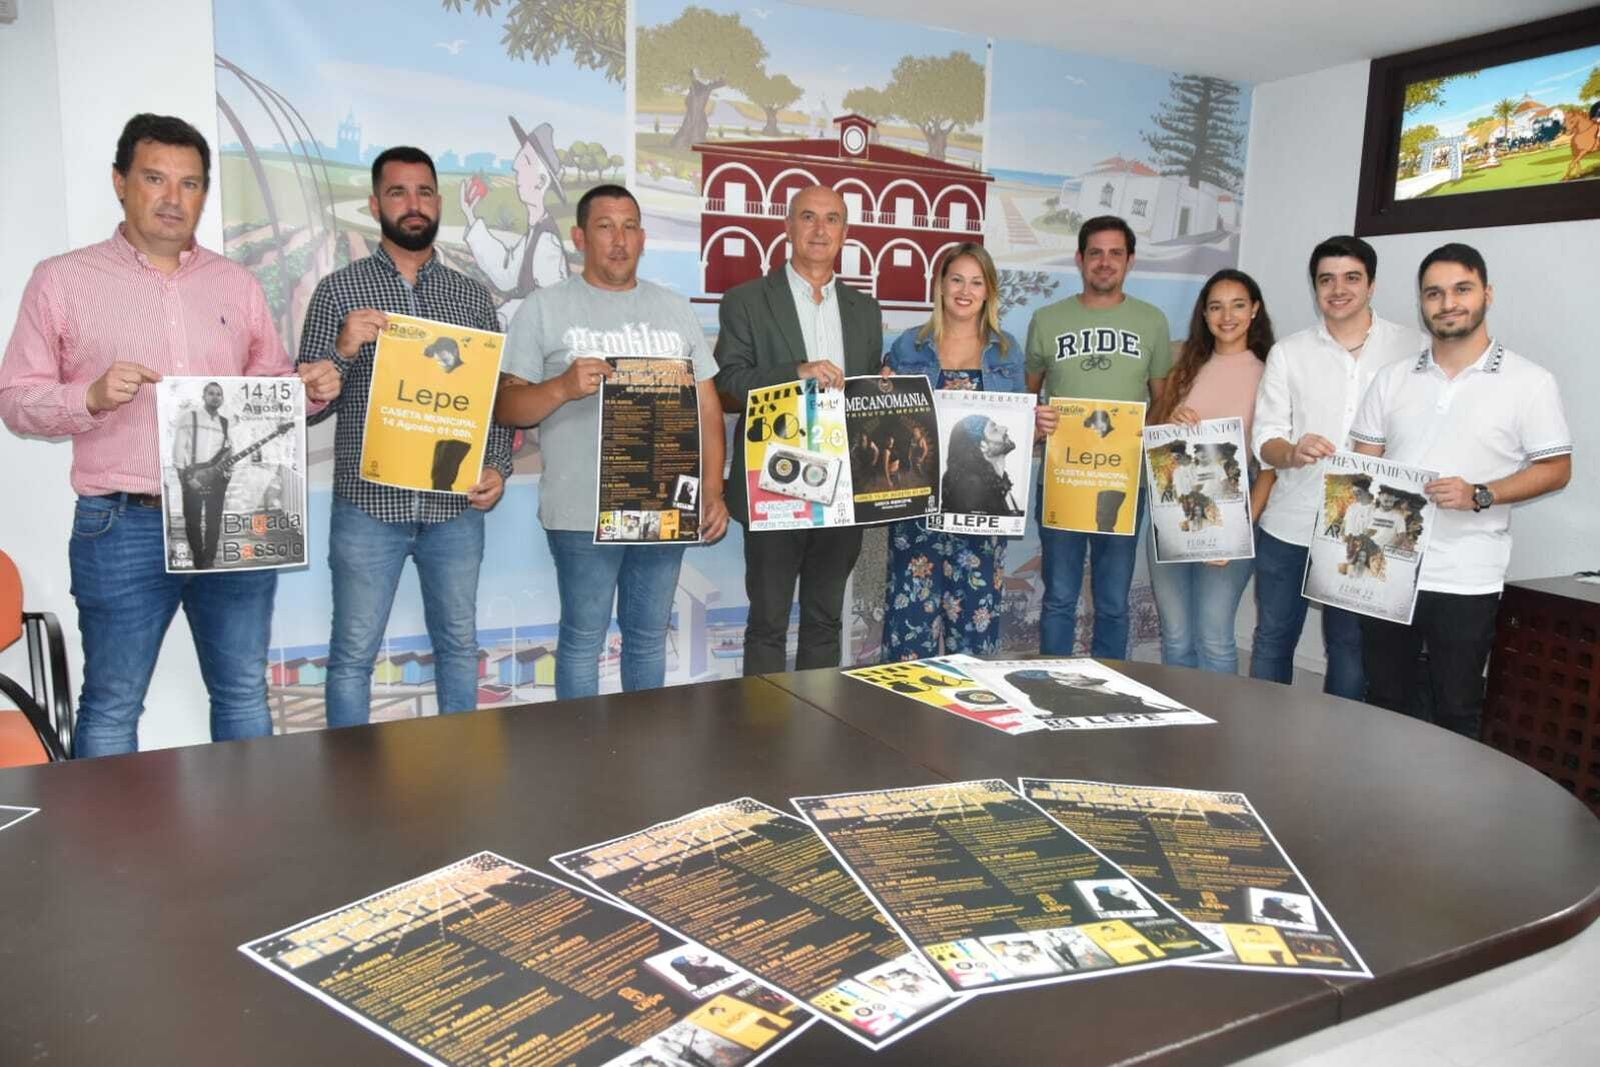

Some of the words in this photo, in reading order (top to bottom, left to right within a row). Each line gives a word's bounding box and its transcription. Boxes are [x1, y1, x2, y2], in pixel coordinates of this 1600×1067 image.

[1055, 327, 1141, 361] RIDE
[241, 383, 263, 400] 14
[269, 383, 291, 400] 15
[397, 379, 470, 412] Lepe
[242, 403, 292, 414] Agosto
[846, 393, 929, 412] MECANOMANIA
[380, 406, 422, 420] CASETA
[423, 412, 478, 429] MUNICIPAL
[847, 410, 885, 418] TRIBUTO
[896, 407, 931, 415] MECANO
[383, 417, 395, 427] 14
[396, 419, 433, 433] Agosto
[1066, 446, 1121, 469] Lepe
[223, 511, 302, 536] Brigada
[930, 516, 942, 525] 16
[953, 514, 1000, 528] LEPE
[223, 541, 303, 562] Bassolo
[1084, 713, 1166, 724] LEPE
